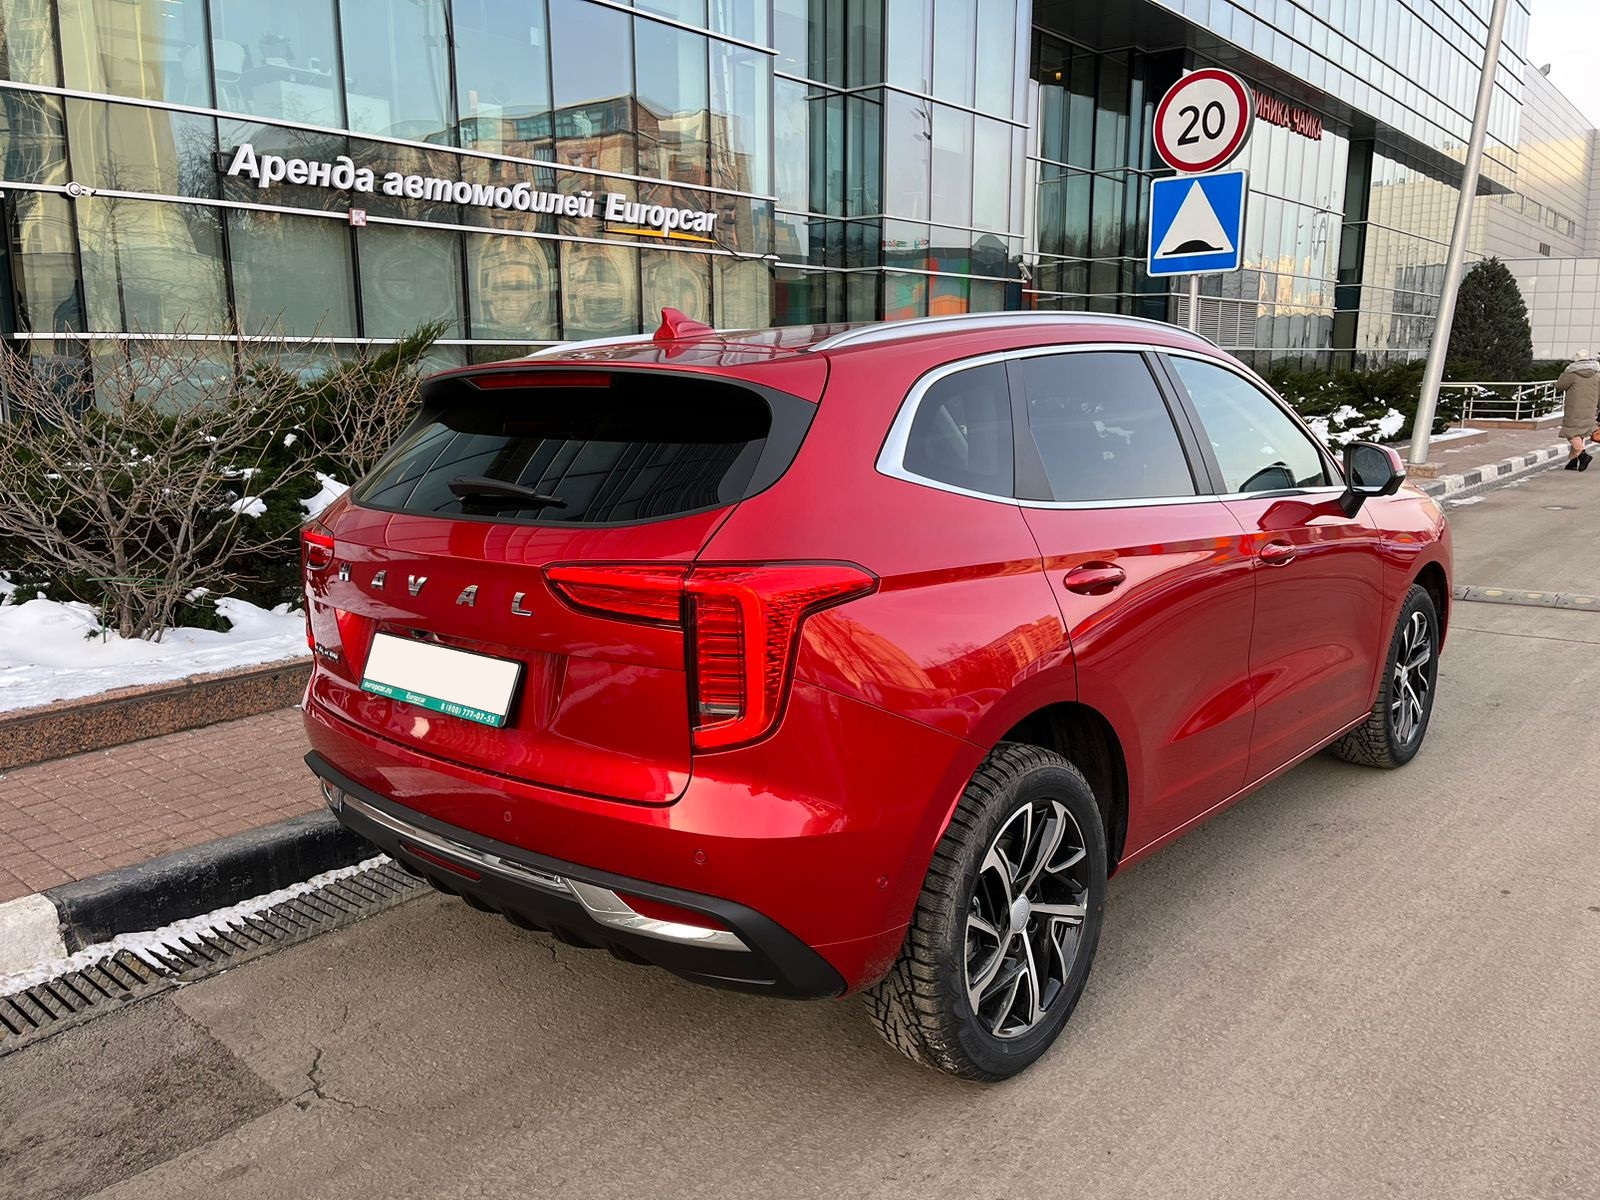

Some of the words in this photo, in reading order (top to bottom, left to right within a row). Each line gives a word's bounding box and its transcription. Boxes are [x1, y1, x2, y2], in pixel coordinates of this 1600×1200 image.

[1177, 101, 1225, 146] 20
[227, 143, 374, 193] Аренда
[382, 171, 595, 219] автомобилей
[605, 192, 718, 238] Europcar
[339, 562, 532, 616] HAVAL
[462, 709, 496, 723] 777-07-55
